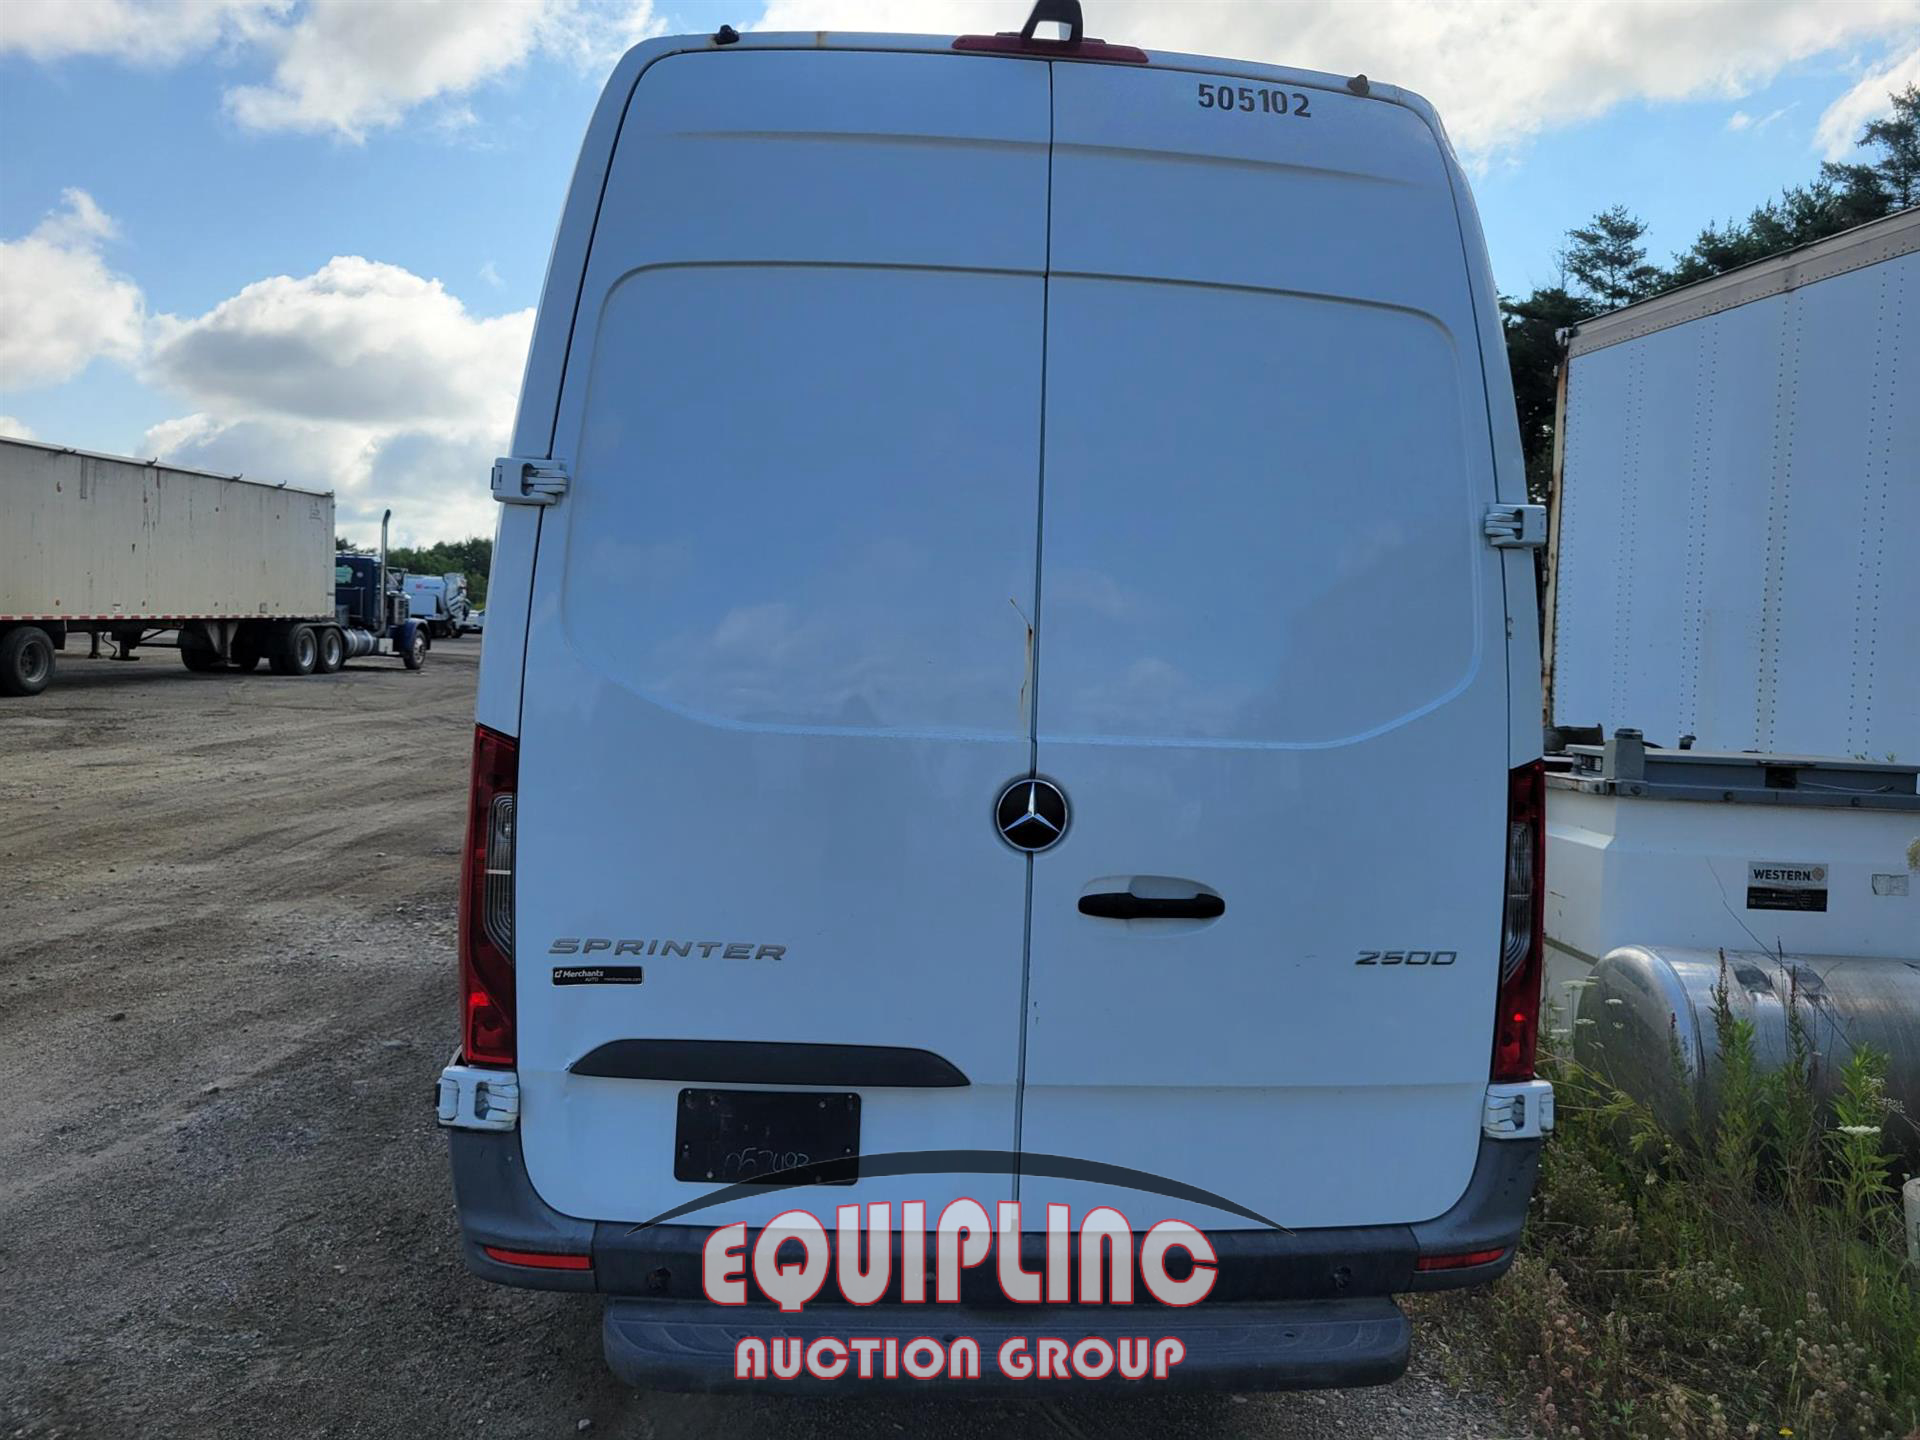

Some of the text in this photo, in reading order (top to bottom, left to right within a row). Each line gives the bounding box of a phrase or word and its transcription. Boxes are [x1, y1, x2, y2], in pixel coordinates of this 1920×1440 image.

[1198, 83, 1311, 118] 505102
[1753, 869, 1811, 881] WESTERN
[549, 938, 787, 961] SPRINTER
[1355, 951, 1457, 965] 2500
[563, 969, 603, 979] Merchants
